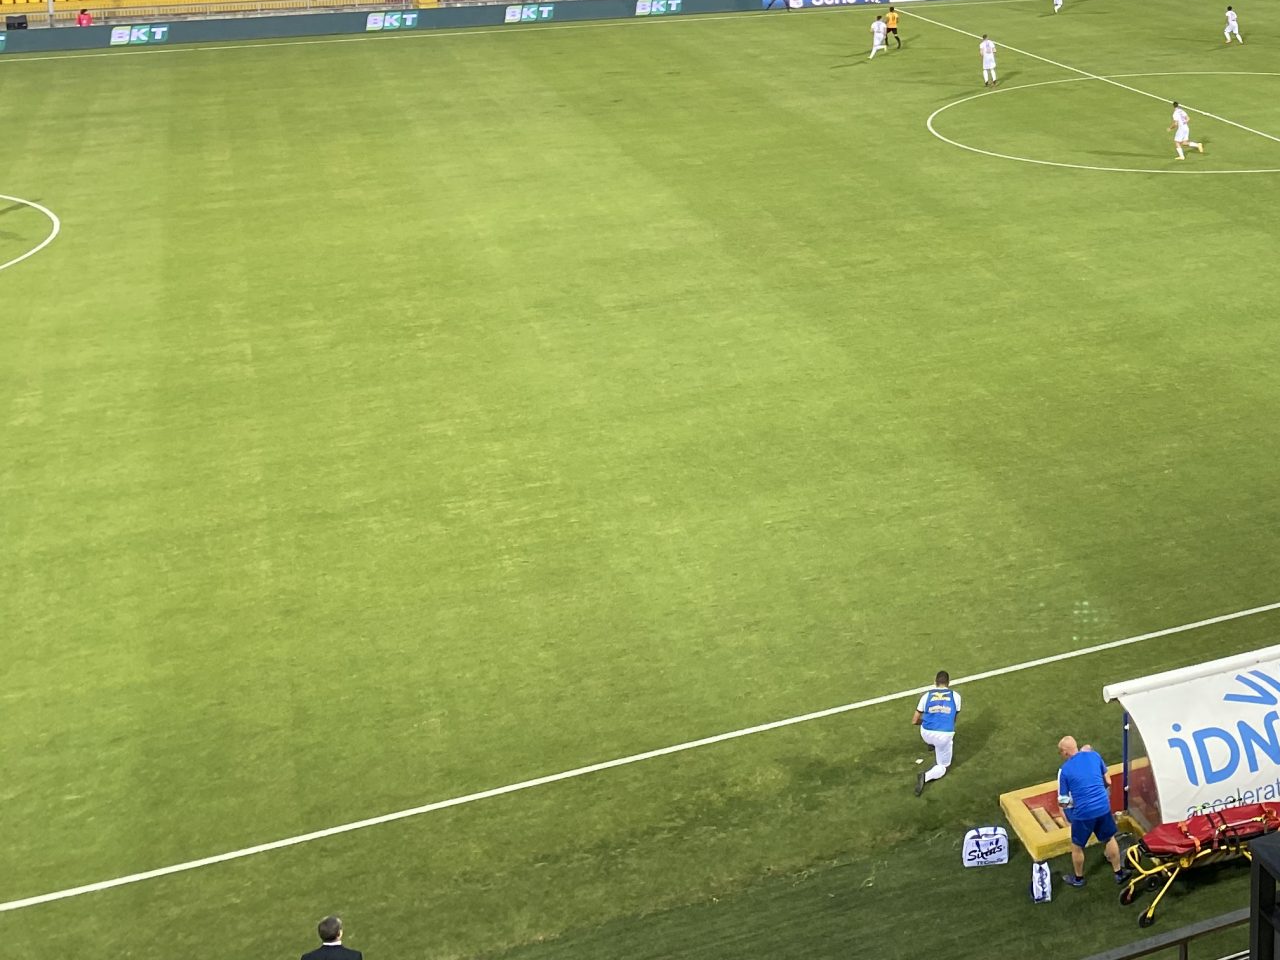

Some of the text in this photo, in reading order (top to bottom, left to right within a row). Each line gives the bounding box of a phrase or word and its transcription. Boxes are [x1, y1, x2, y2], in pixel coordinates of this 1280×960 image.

[366, 11, 419, 32] BKT
[504, 3, 554, 24] BKT
[110, 24, 168, 46] BKT
